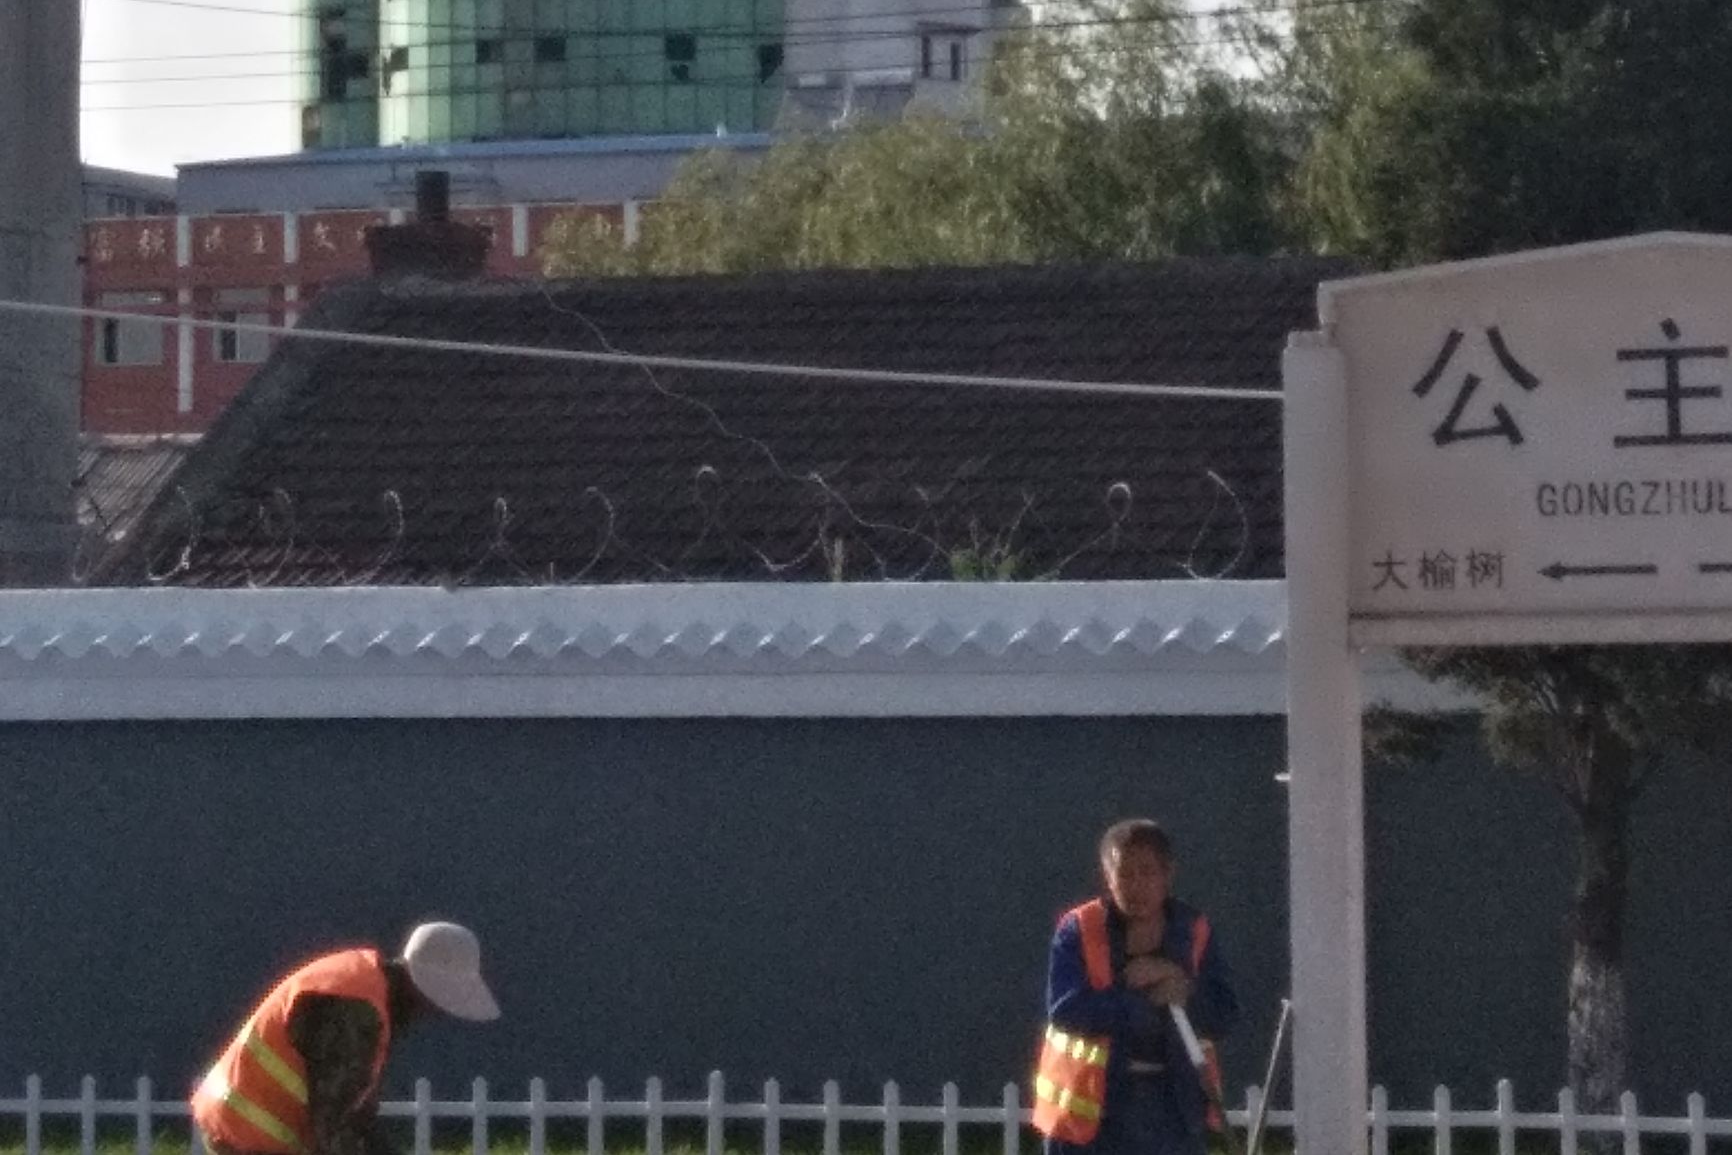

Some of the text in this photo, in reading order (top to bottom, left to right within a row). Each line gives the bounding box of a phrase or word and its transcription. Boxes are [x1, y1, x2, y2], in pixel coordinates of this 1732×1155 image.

[1411, 317, 1732, 447] 公主
[1536, 479, 1732, 517] GONGZHUL
[1371, 549, 1506, 591] 大榆树
